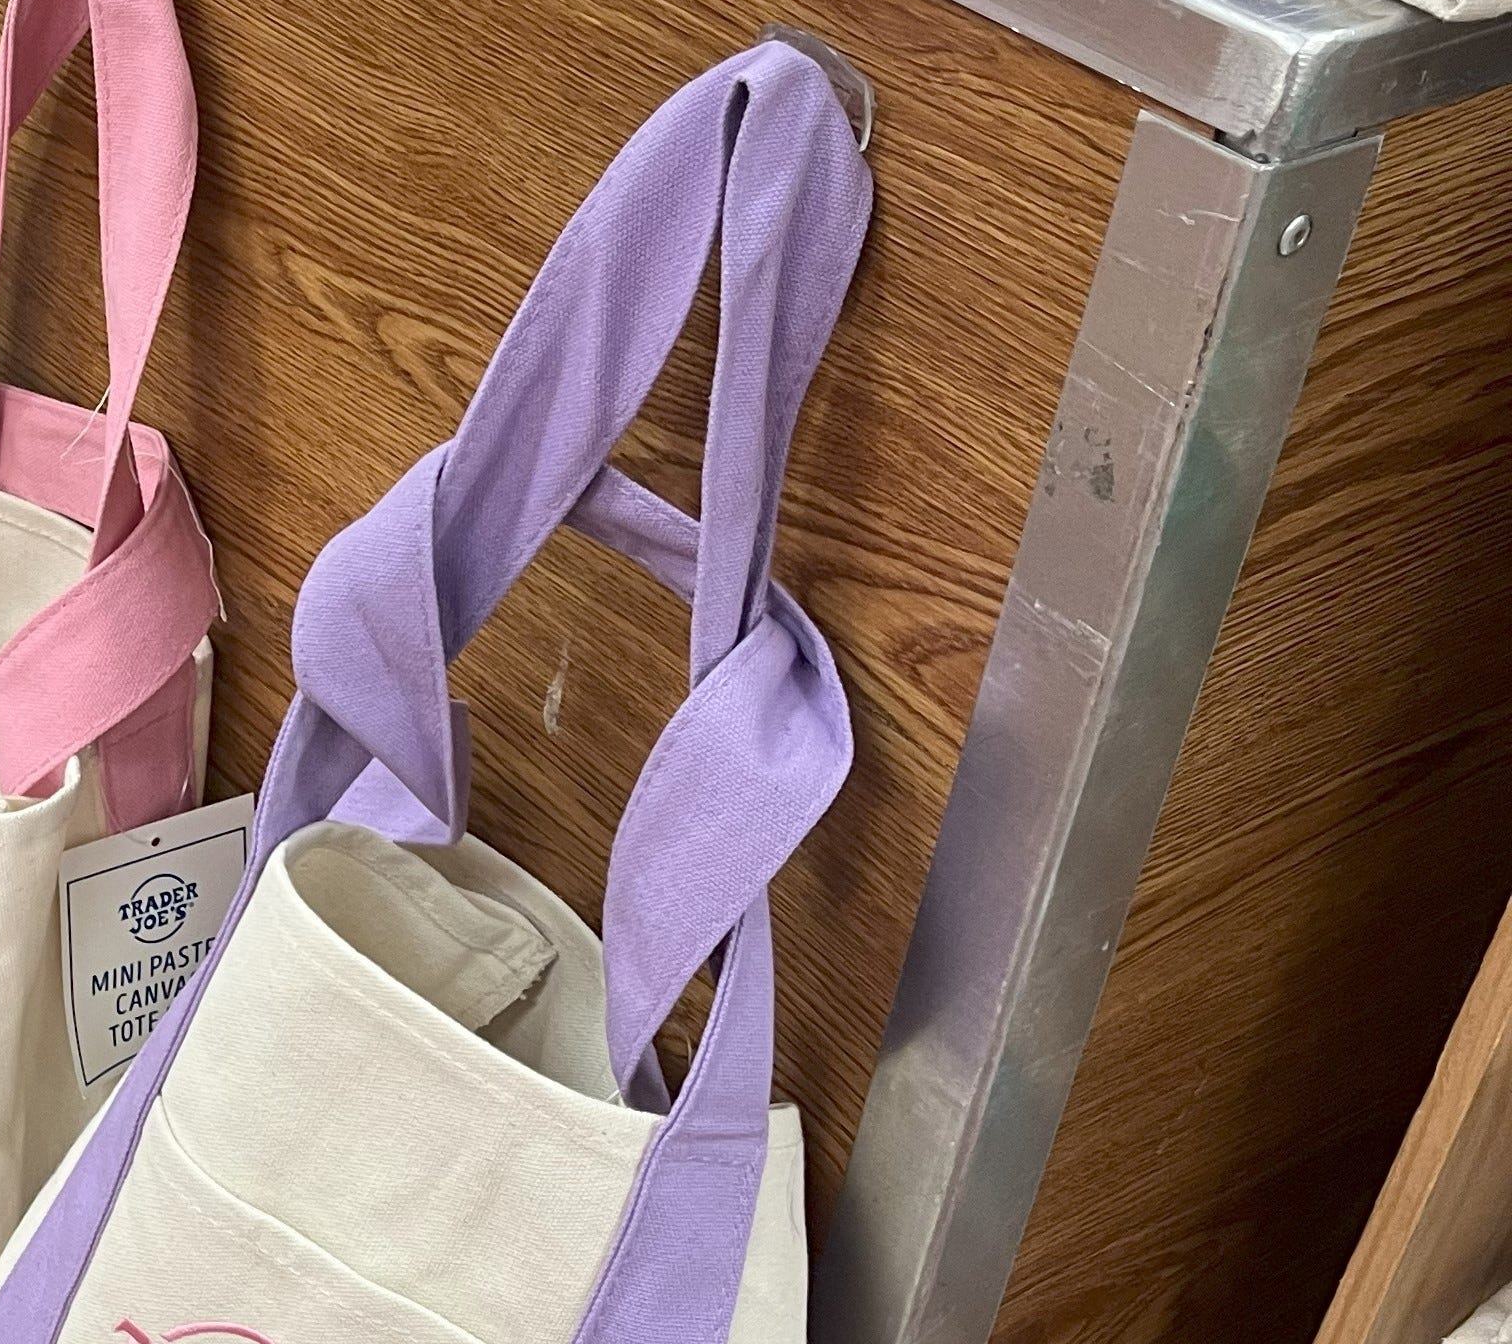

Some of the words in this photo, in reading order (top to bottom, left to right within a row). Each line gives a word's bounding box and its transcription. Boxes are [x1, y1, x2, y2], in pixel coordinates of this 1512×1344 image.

[118, 881, 200, 922] TRADER
[128, 903, 188, 935] JOE'S
[91, 959, 143, 997] MINI
[149, 936, 217, 978] PASTE
[115, 969, 197, 1016] CANVA
